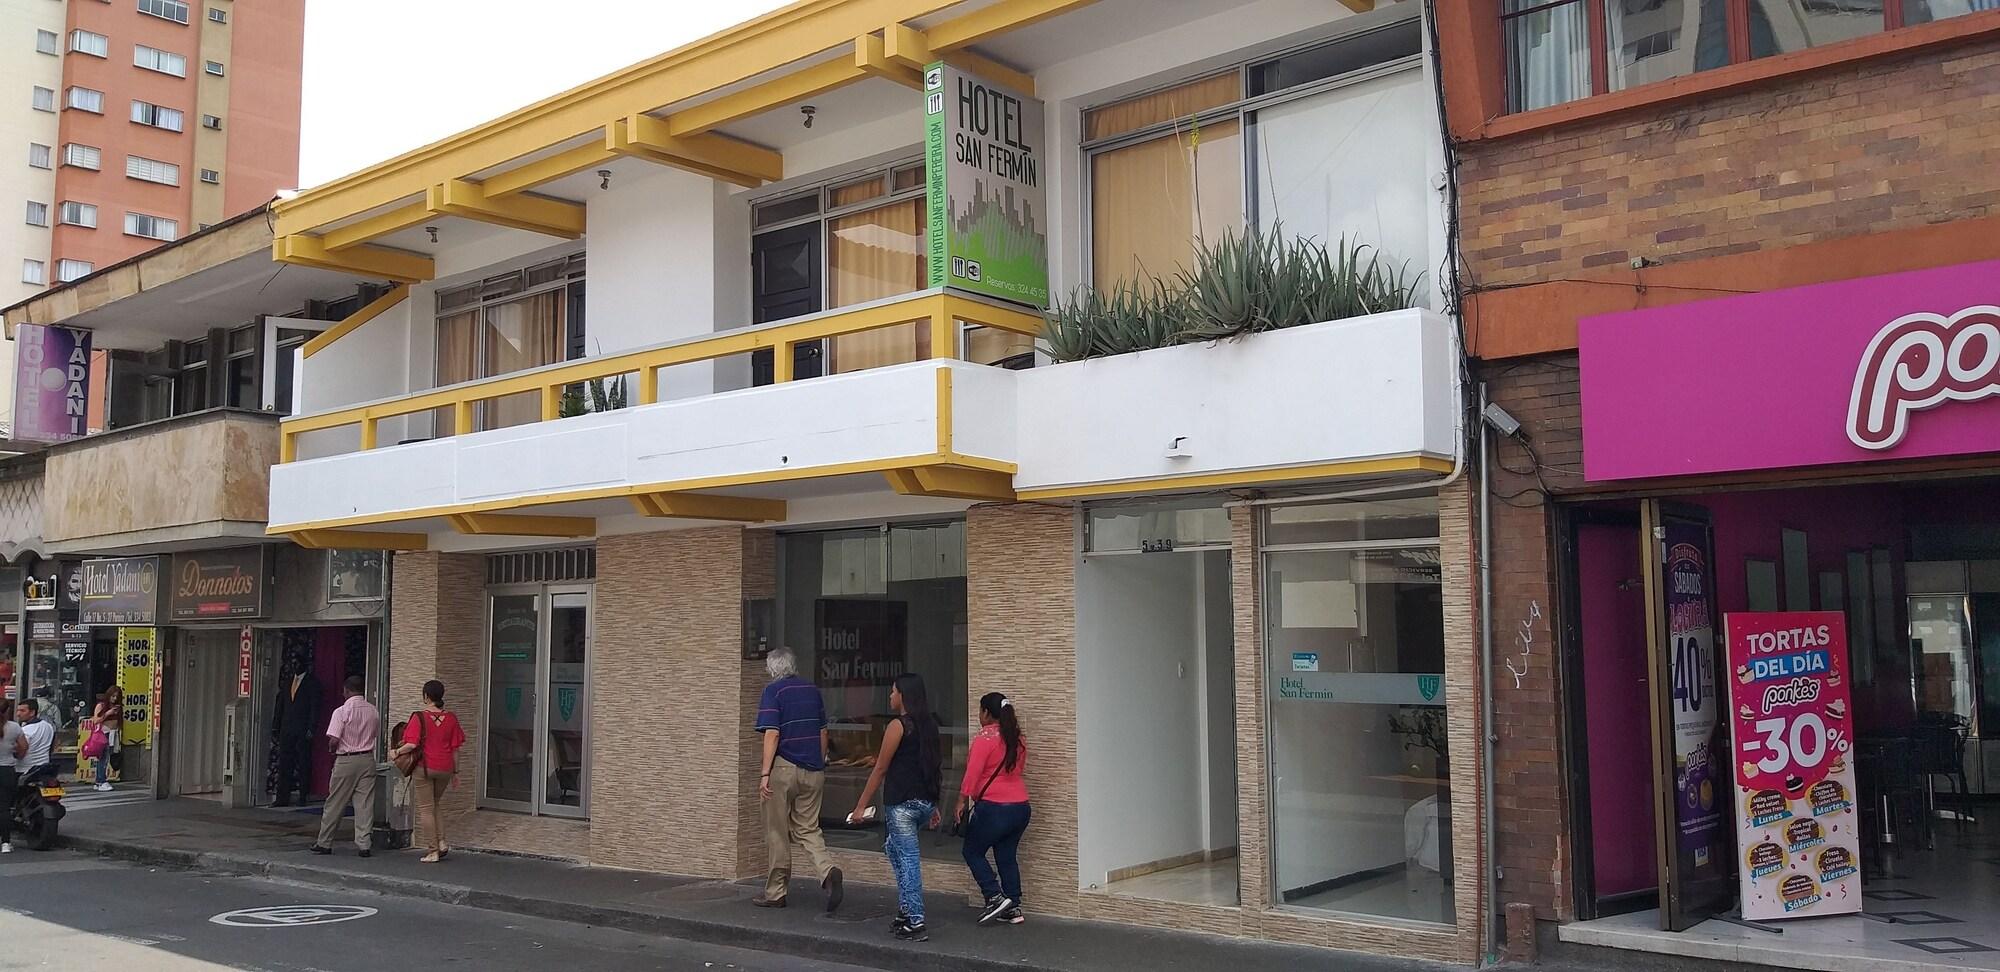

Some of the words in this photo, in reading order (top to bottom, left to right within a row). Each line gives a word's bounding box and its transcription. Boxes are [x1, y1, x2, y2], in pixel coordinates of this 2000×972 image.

[958, 76, 1031, 153] HOTEL
[956, 132, 982, 170] SAN
[988, 143, 1036, 188] FERMÍN
[930, 121, 944, 284] WWW.HOTELSANFERMINPEREIRA.COM
[19, 325, 45, 435] HOTEL
[66, 329, 88, 434] YADANI
[84, 564, 110, 595] Hotel
[111, 562, 141, 595] Yadani
[1674, 568, 1701, 594] SÁBADOS
[128, 639, 150, 651] HOR
[822, 627, 861, 650] Hotel
[1747, 625, 1830, 654] TORTAS
[241, 624, 251, 695] HOTEL
[822, 656, 849, 680] San
[1755, 659, 1789, 679] DEL
[1792, 651, 1825, 673] DÍA
[1280, 676, 1303, 688] Hotel
[1280, 687, 1297, 698] San
[1743, 712, 1849, 774] -30%
[1758, 813, 1783, 825] Lunes
[1815, 802, 1844, 815] Martes
[1790, 838, 1825, 852] Miércoles
[1755, 863, 1782, 878] Jueves
[1822, 867, 1852, 881] Viernes
[1788, 894, 1819, 910] Sábado
